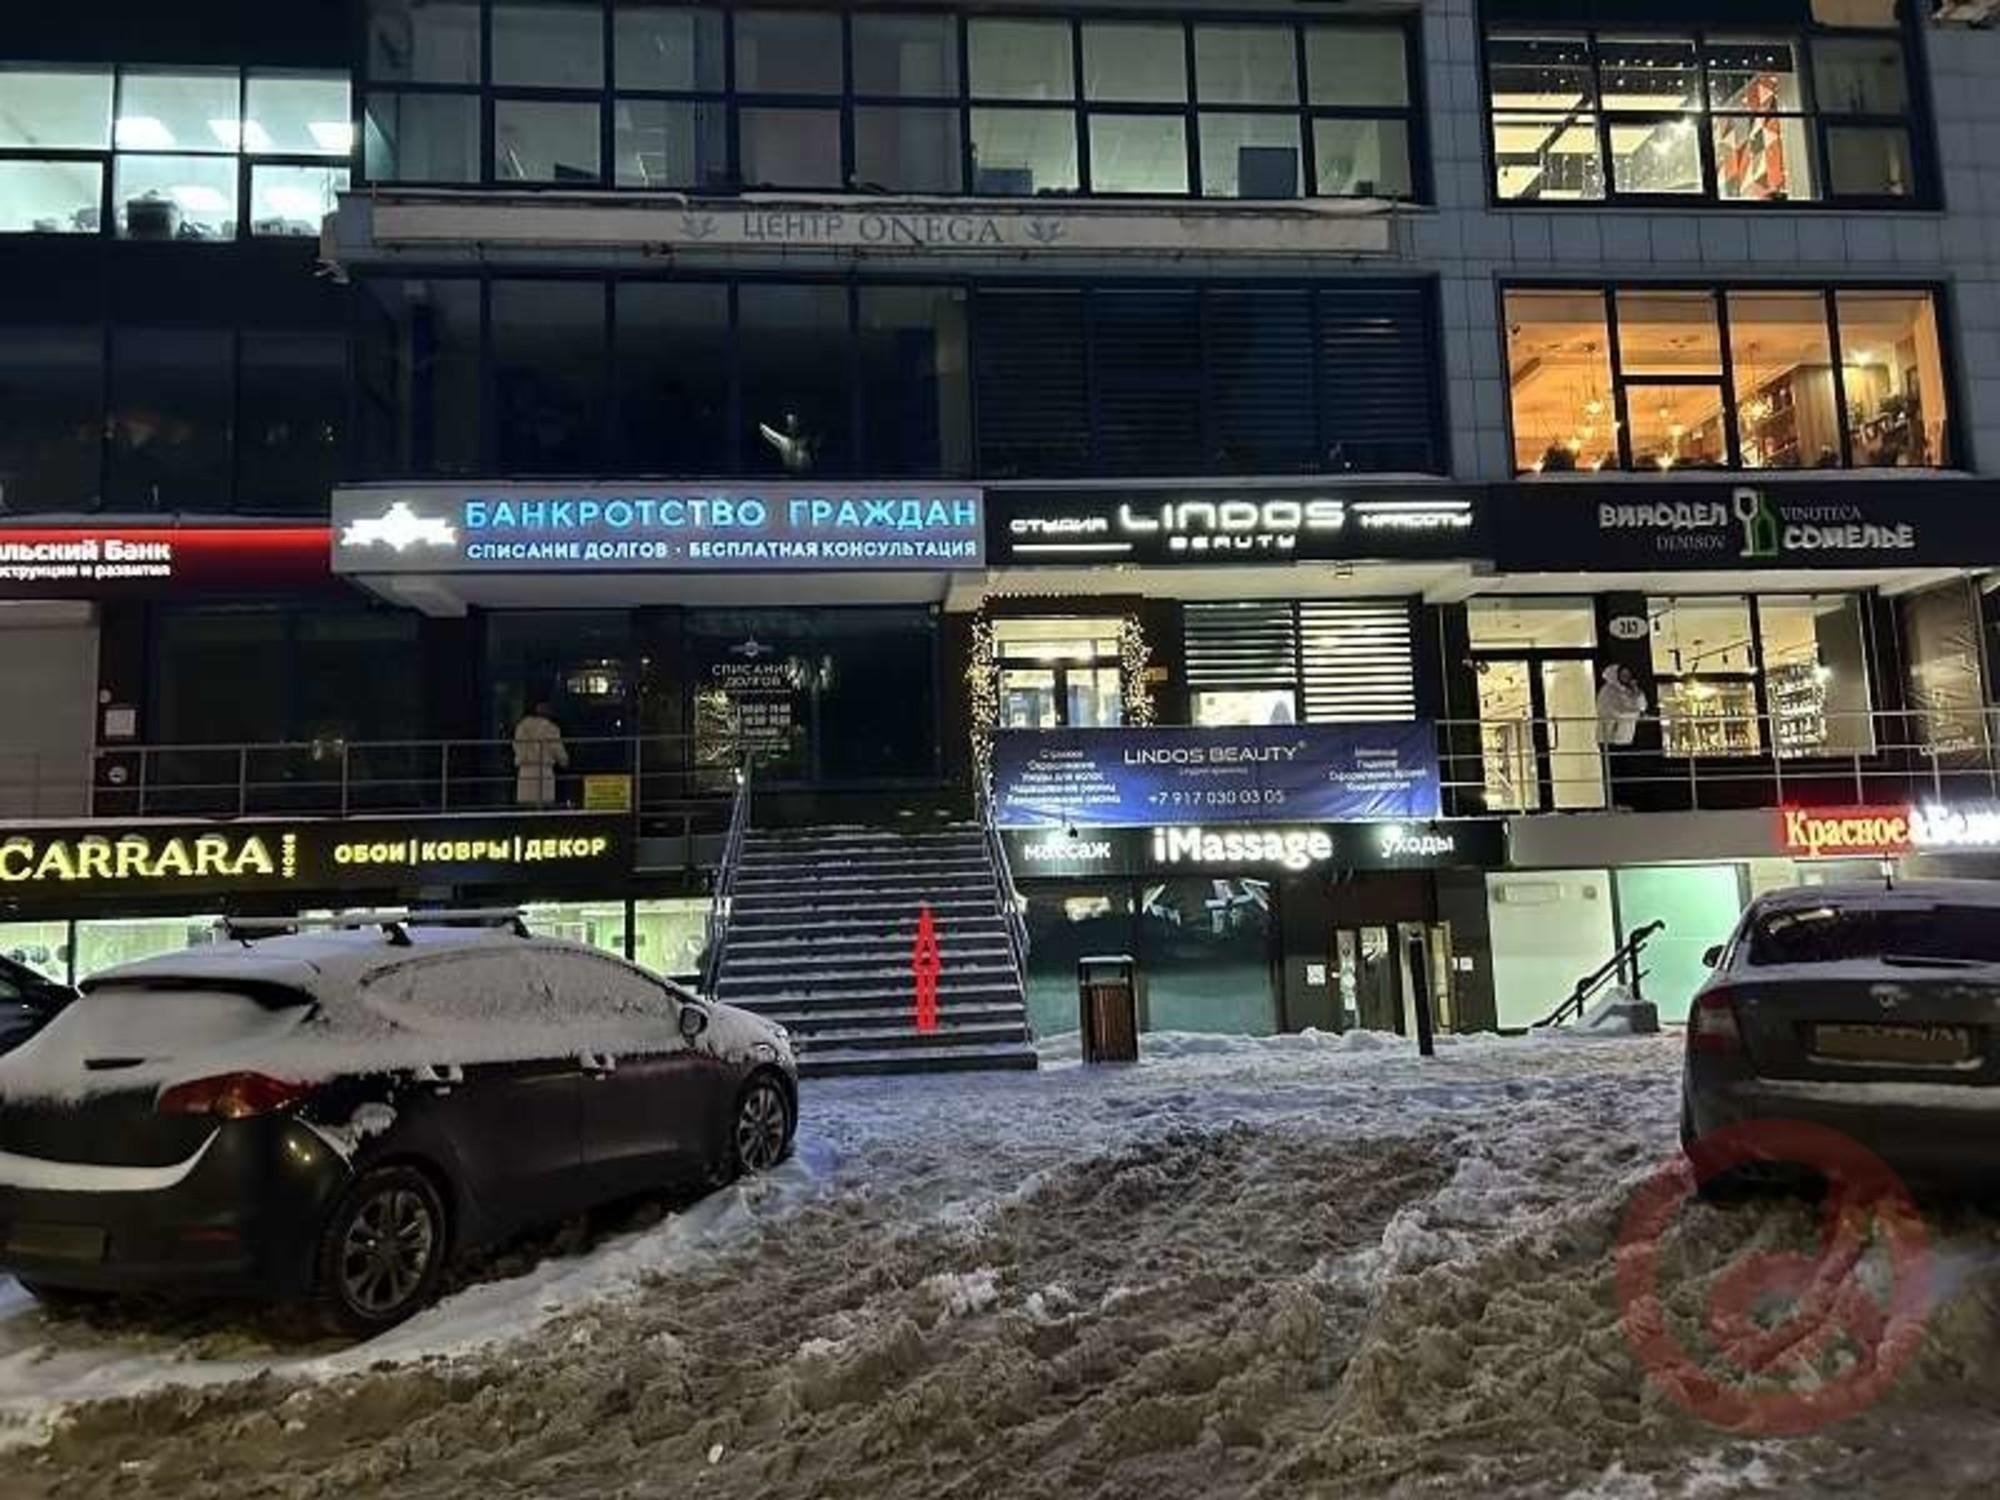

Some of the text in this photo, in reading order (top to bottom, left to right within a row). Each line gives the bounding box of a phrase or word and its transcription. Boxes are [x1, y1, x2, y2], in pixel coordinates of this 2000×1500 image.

[740, 213, 1004, 245] ЦЕНТР ONEGA
[466, 499, 976, 530] БАНКРОТСТВО ГРАЖДАН
[1119, 502, 1345, 529] LINDOS
[1600, 502, 1729, 529] ВИНОДЕЛ
[1169, 535, 1296, 549] BEAUTY
[1784, 523, 1916, 549] СОМЕЛЬЕ
[104, 540, 171, 560] Банк
[467, 540, 977, 560] СПИСАНИЕ ДОЛГОВ БЕСПЛАТНАЯ КОНСУЛЬТАЦИЯ
[0, 565, 171, 580] струкции и развития
[1124, 747, 1297, 764] LINDOS BEAUTY
[1149, 793, 1168, 805] +7
[1172, 792, 1201, 805] 917
[1380, 834, 1454, 858] уходы
[1785, 811, 1906, 857] Красное
[0, 836, 274, 881] CARRARA
[334, 838, 606, 863] ОБОИ КОВРЫ ДЕКОР
[1023, 842, 1111, 860] массаж
[1154, 828, 1333, 869] iMassage
